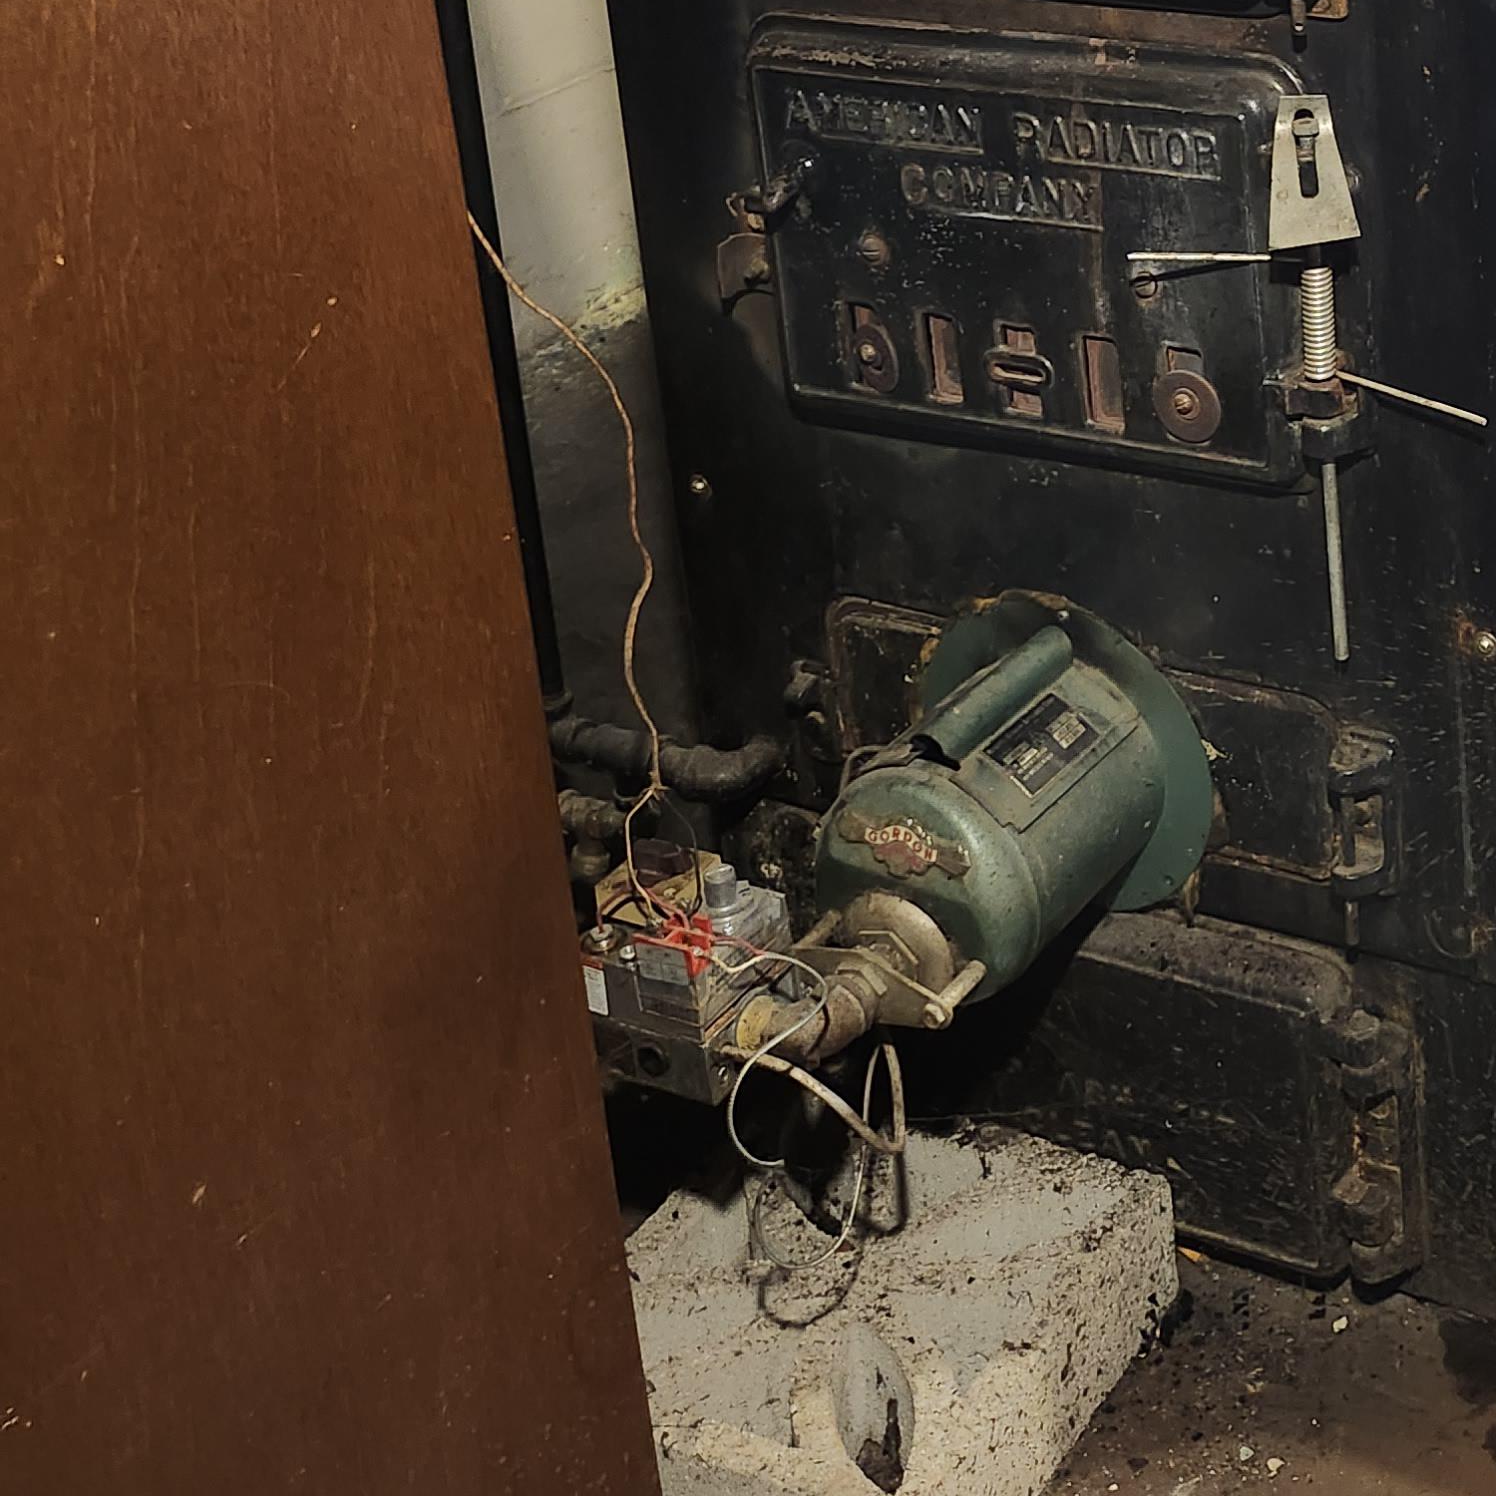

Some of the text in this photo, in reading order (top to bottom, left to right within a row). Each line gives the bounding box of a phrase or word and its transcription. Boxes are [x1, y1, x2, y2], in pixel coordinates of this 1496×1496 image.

[786, 90, 1219, 180] AMERICAN RADIATOR
[901, 163, 1098, 222] COMPANY
[868, 827, 933, 861] GORDON
